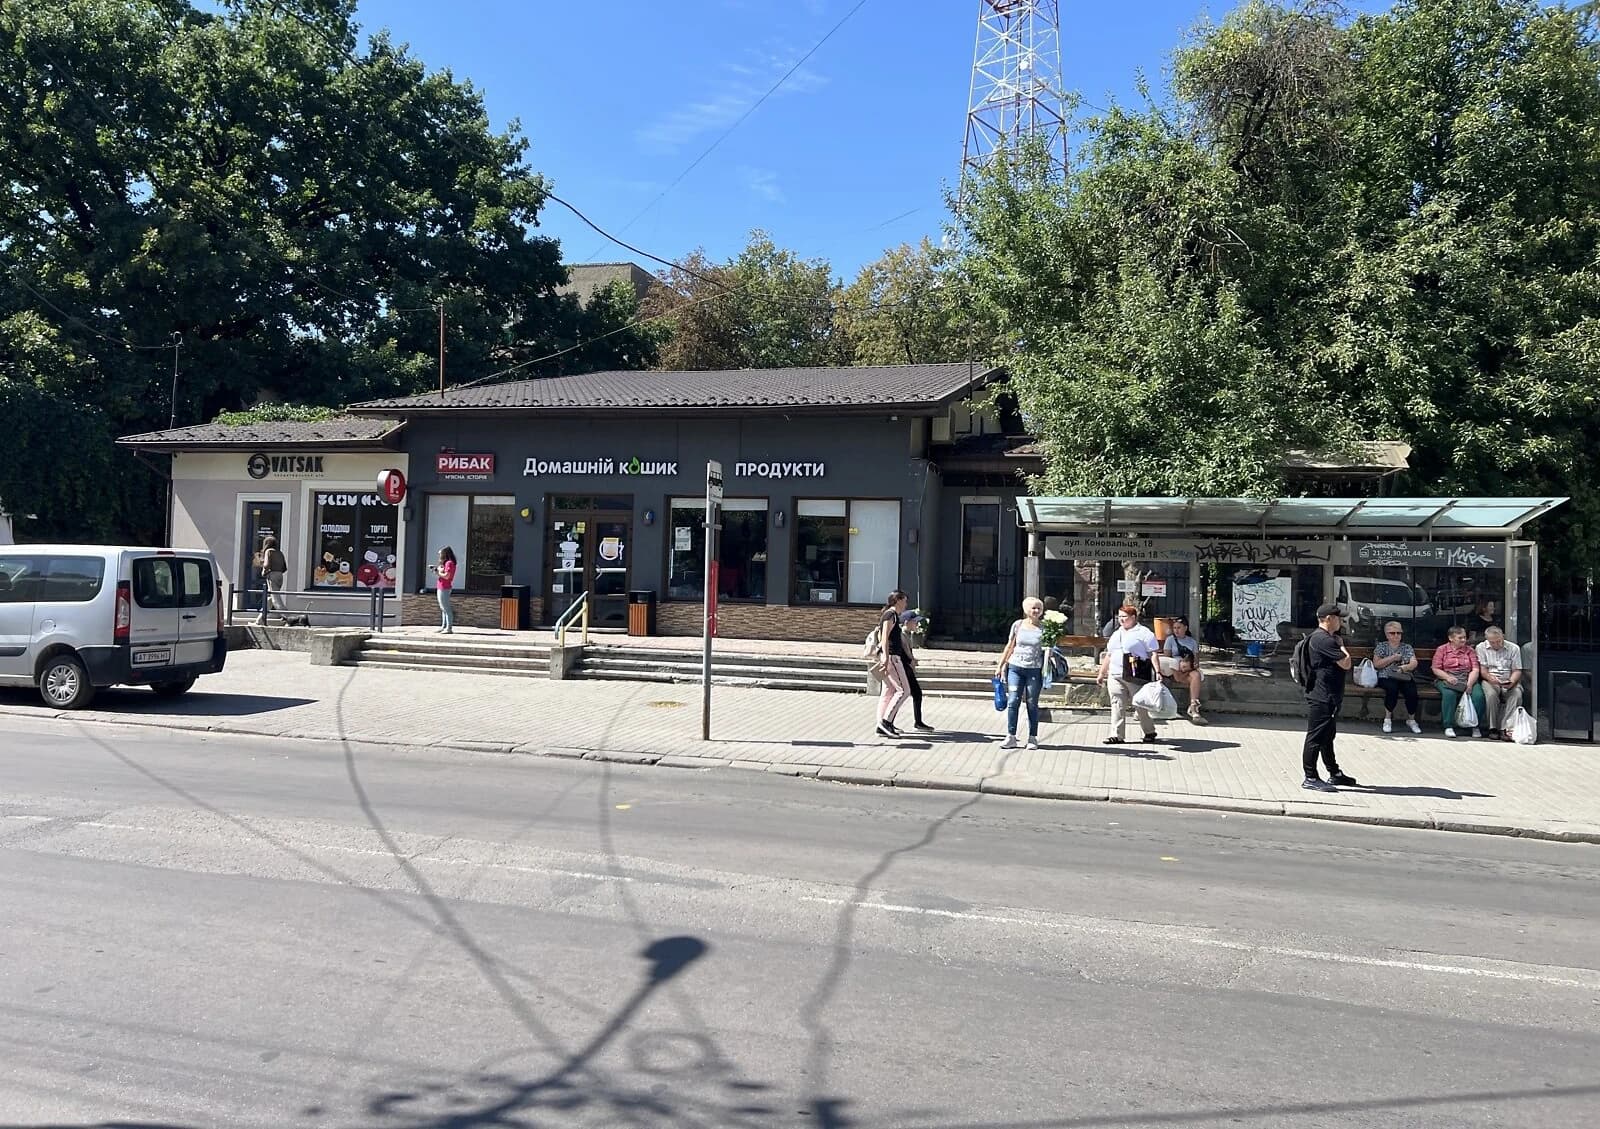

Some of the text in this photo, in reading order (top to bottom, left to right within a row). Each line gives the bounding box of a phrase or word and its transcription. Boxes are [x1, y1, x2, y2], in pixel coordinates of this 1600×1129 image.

[271, 456, 324, 472] VATSAK
[438, 457, 491, 470] РИБАК
[523, 456, 678, 476] Домашній кошик
[735, 462, 825, 479] ПРОДУКТИ
[370, 525, 389, 534] ТОРТИ
[1143, 539, 1153, 547] 18
[1059, 549, 1092, 558] vulytsia
[1094, 550, 1146, 559] Konovaltsia
